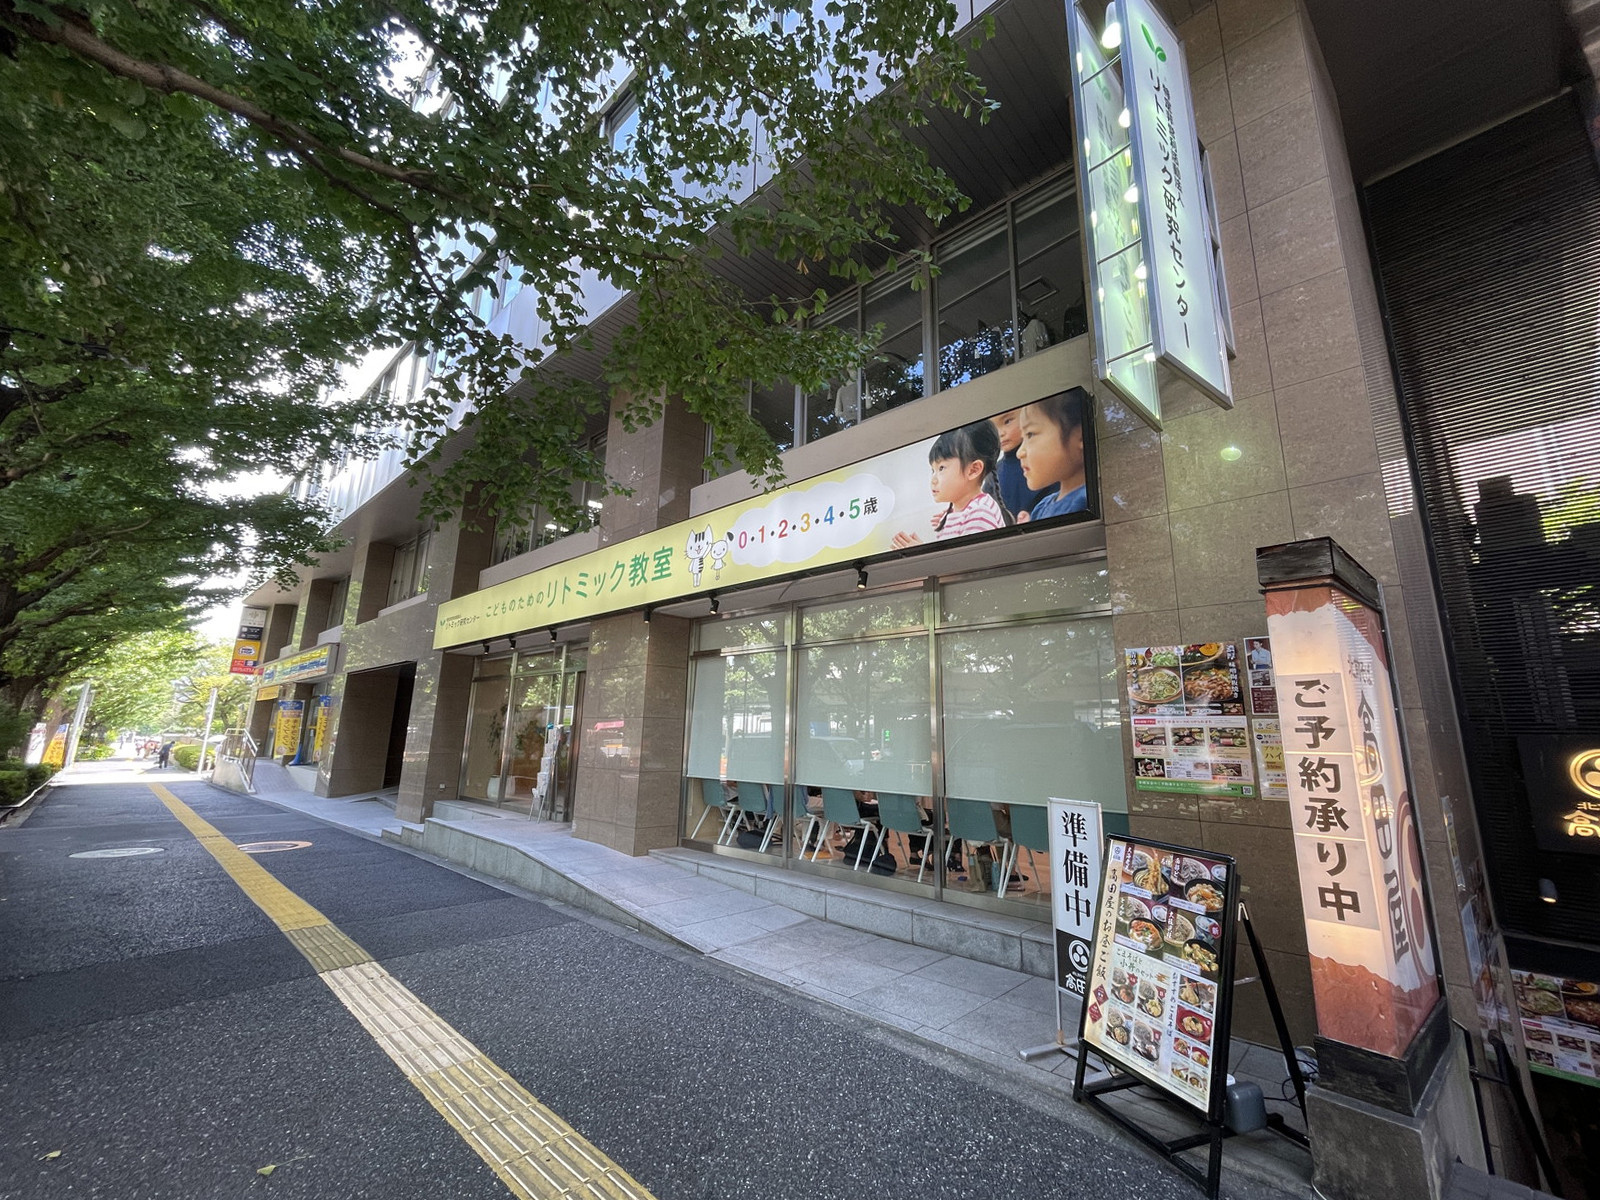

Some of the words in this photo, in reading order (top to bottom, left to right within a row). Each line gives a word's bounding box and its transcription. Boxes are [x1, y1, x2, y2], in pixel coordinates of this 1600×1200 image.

[1149, 68, 1190, 349] リトミック研究センター
[1061, 810, 1091, 926] 準備中
[1293, 679, 1361, 922] ご予約承り中
